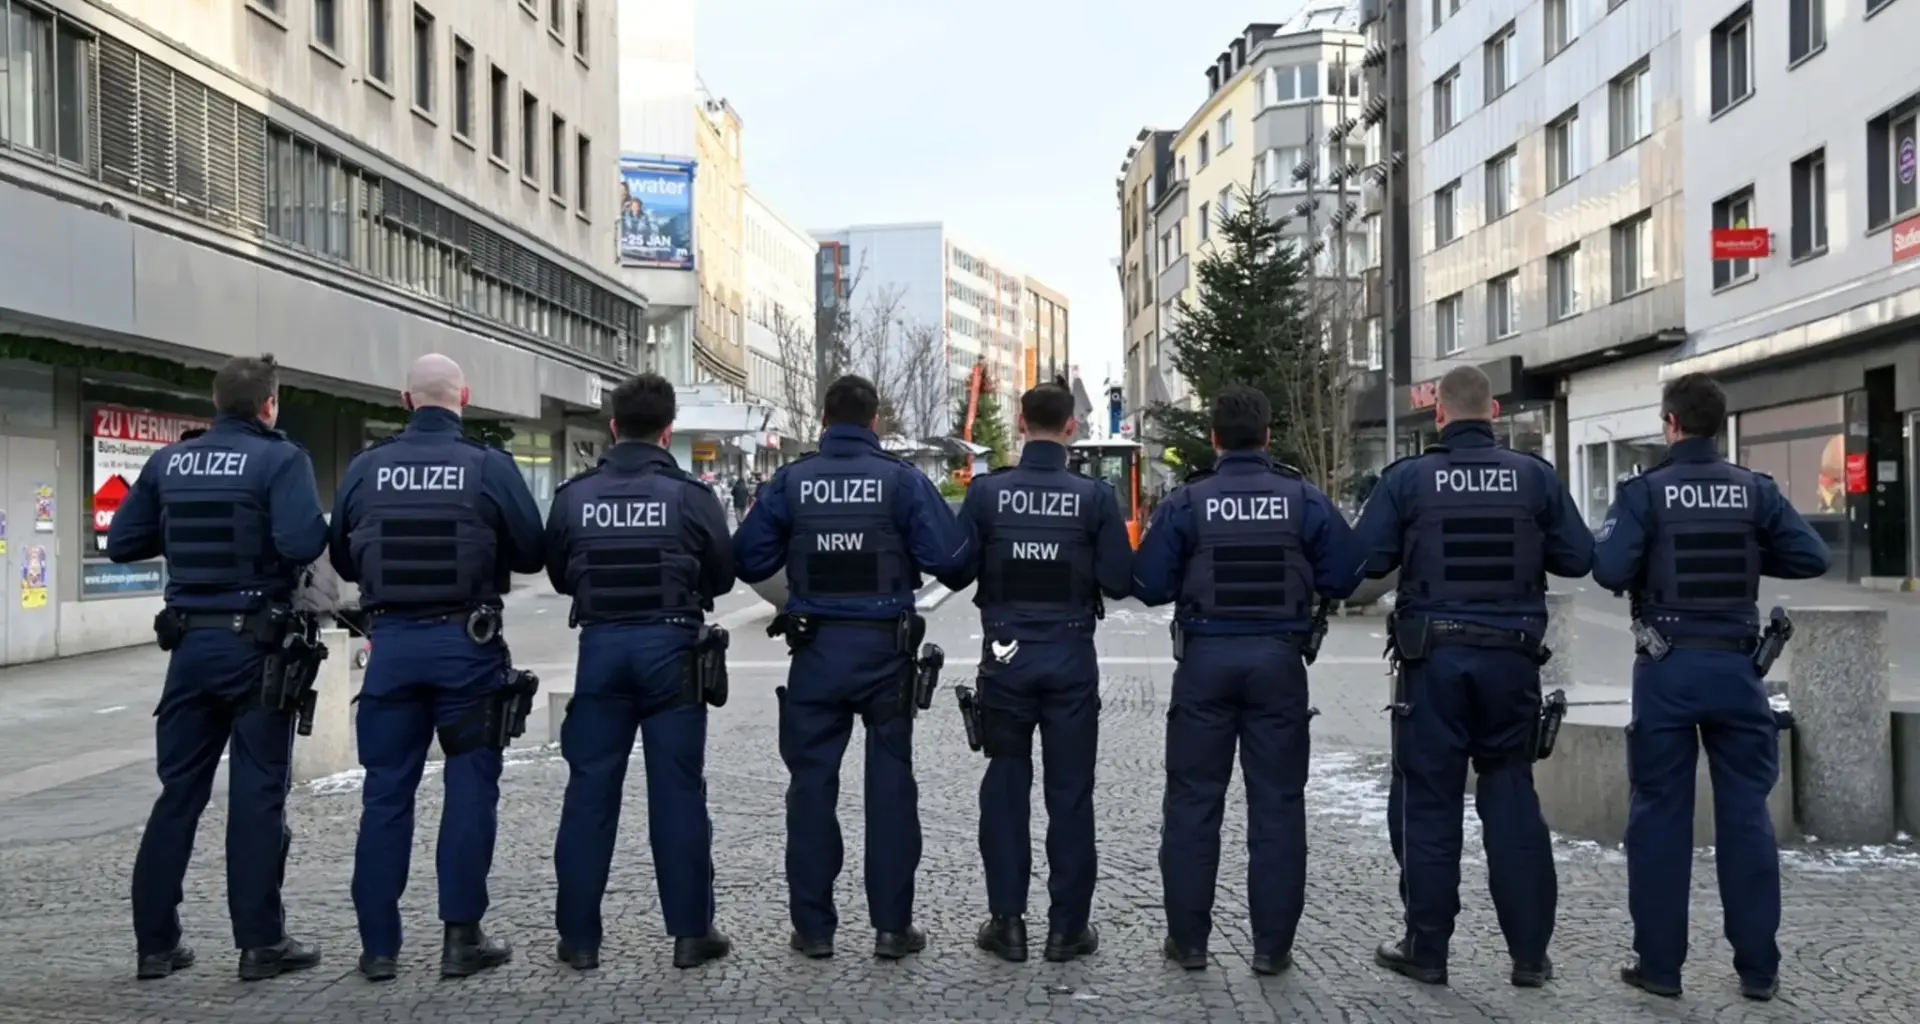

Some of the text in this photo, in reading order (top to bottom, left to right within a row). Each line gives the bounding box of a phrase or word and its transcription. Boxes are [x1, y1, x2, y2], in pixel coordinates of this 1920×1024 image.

[627, 177, 686, 195] water
[646, 235, 672, 246] JAN
[97, 410, 121, 437] ZU
[166, 452, 248, 476] POLIZEI
[376, 465, 466, 491] POLIZEI
[1435, 467, 1518, 493] POLIZEI
[800, 479, 883, 504] POLIZEI
[998, 489, 1080, 517] POLIZEI
[1664, 484, 1748, 509] POLIZEI
[581, 502, 667, 528] POLIZEI
[1206, 496, 1289, 521] POLIZEI
[816, 532, 864, 551] NRW
[1012, 541, 1060, 560] NRW
